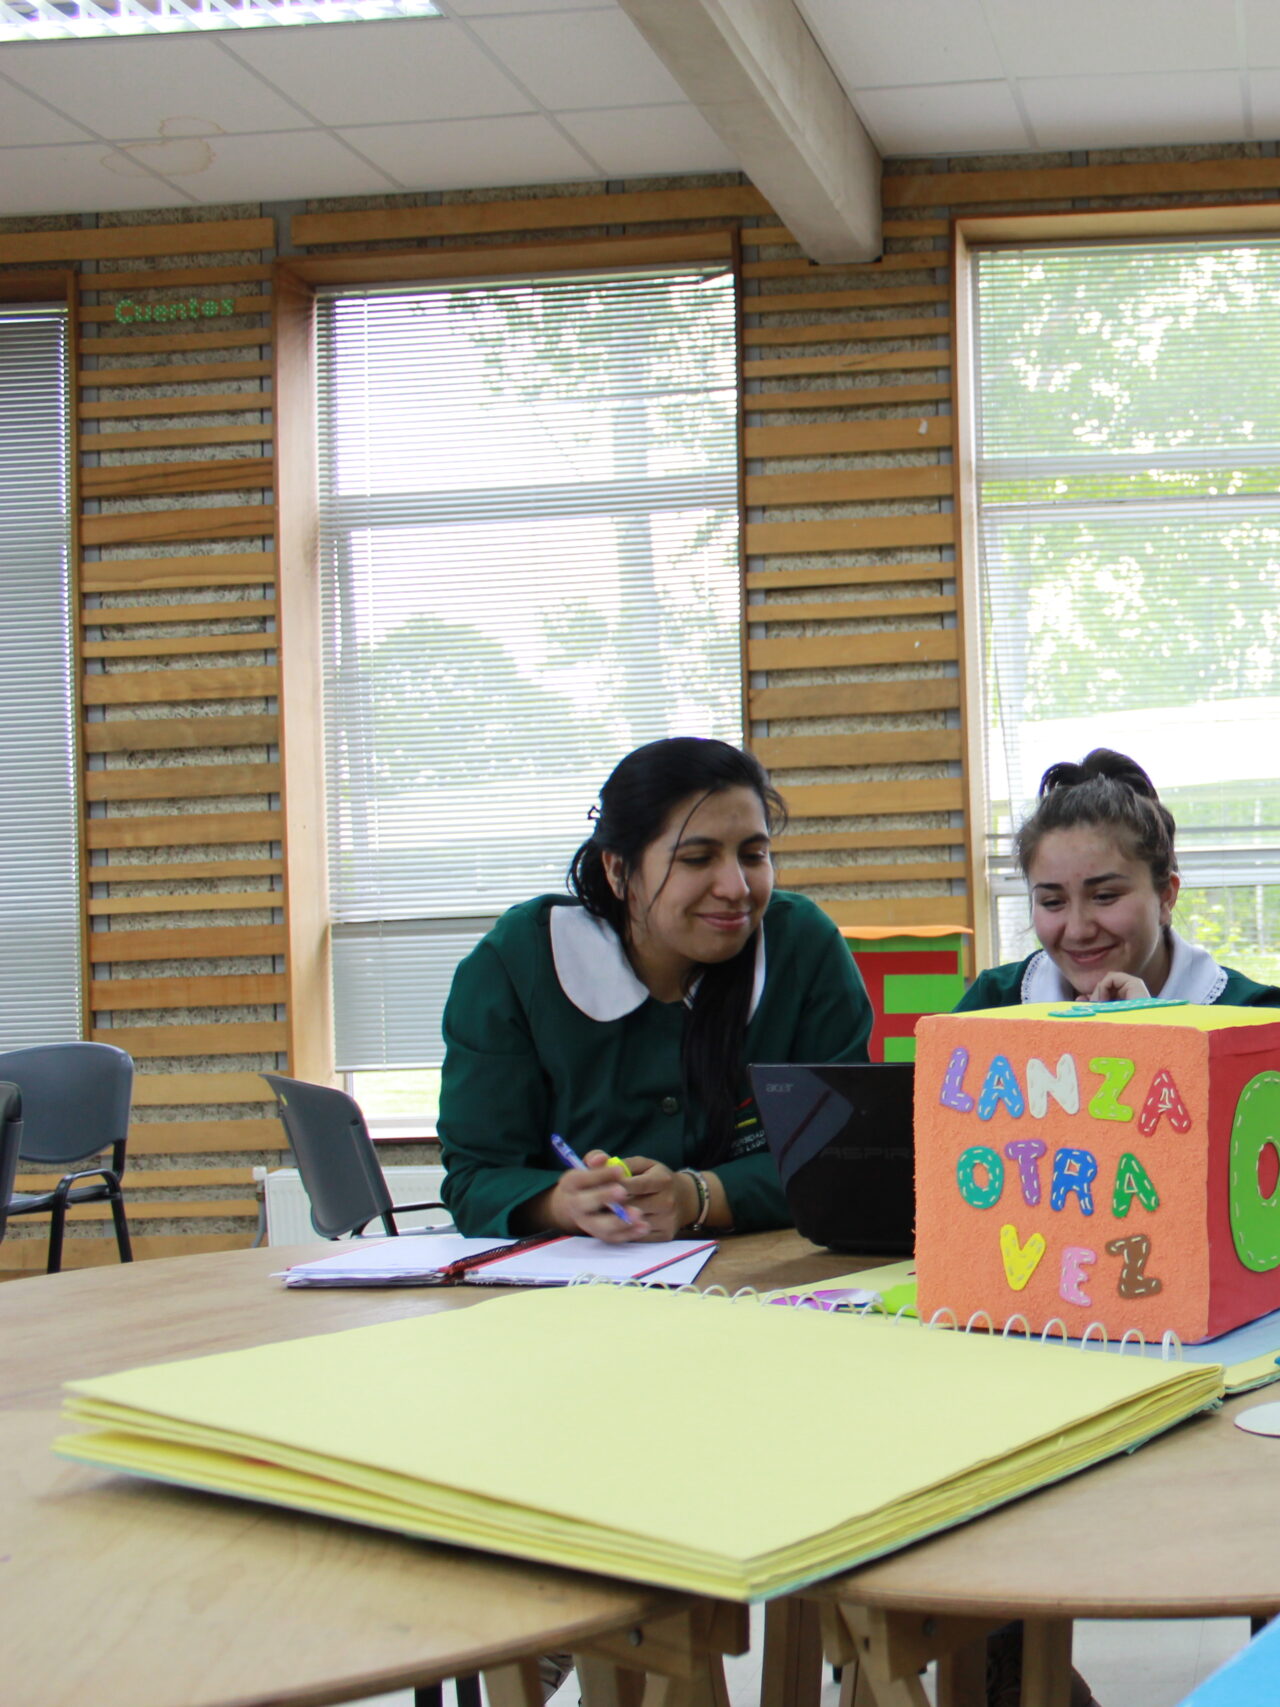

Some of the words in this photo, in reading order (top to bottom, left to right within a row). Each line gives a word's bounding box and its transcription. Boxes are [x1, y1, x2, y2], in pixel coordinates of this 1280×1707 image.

[114, 297, 236, 324] Cuentos
[765, 1083, 794, 1093] acer
[939, 1047, 1191, 1137] LANZA
[819, 1147, 911, 1160] ASPIR
[957, 1139, 1160, 1218] OTRA
[1000, 1224, 1163, 1306] VEZ
